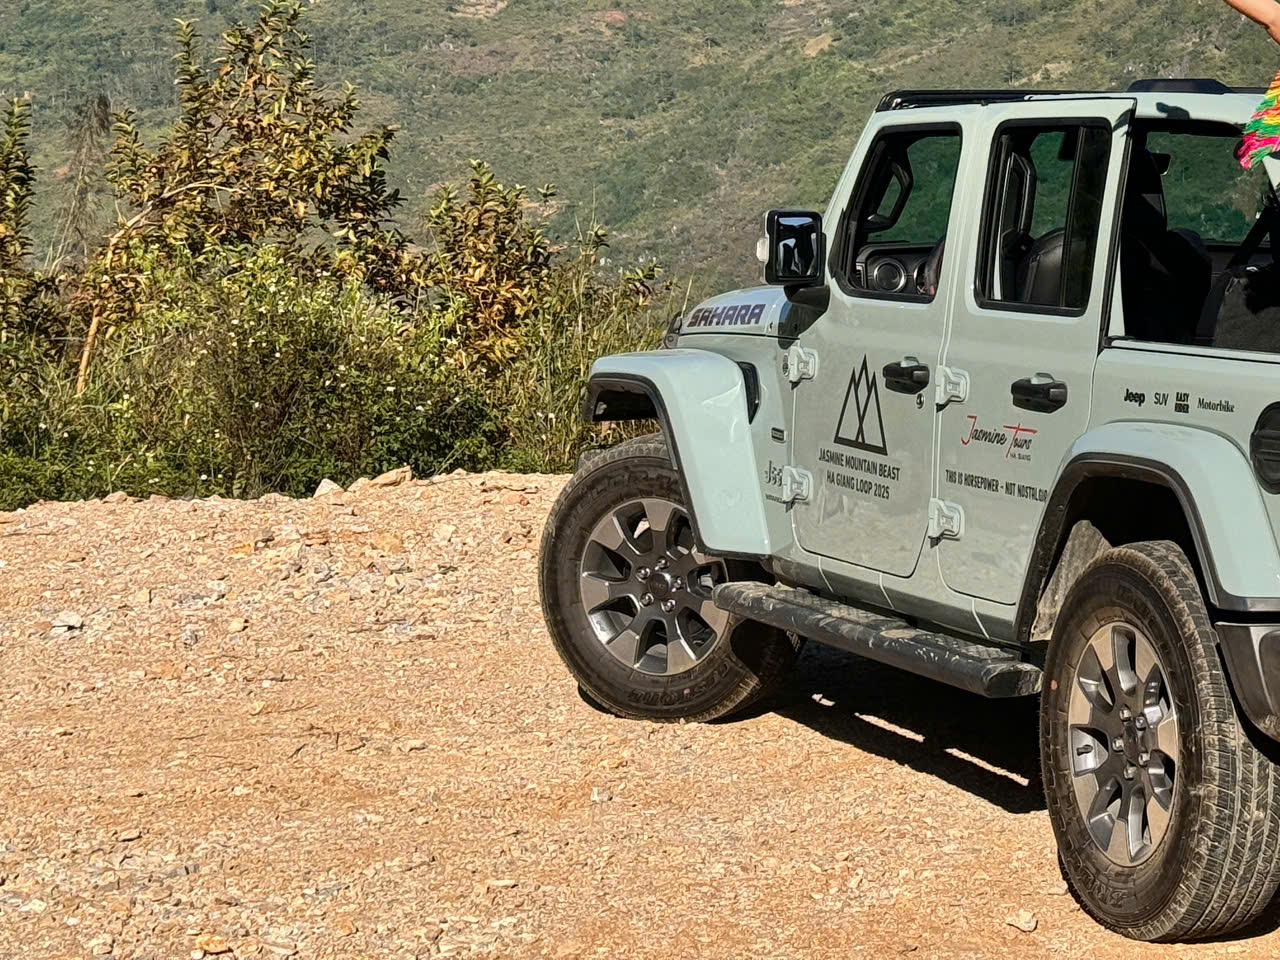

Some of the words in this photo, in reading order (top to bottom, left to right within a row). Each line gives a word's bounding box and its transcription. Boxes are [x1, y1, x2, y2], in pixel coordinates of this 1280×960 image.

[687, 304, 766, 327] SAHARA
[1124, 388, 1146, 407] Jeep
[1154, 392, 1169, 406] SUV
[1197, 398, 1236, 413] Motorbike
[961, 415, 1007, 446] Jasmine
[1003, 422, 1038, 458] Tours
[766, 460, 783, 488] Jee
[819, 448, 845, 467] JASMINE
[845, 455, 878, 478] MOUNTAIN
[878, 463, 901, 482] BEAST
[827, 470, 836, 485] HA
[836, 474, 855, 491] GIANG
[856, 479, 873, 495] LOOP
[874, 483, 890, 500] 2025
[946, 469, 957, 484] THIS
[958, 472, 963, 485] IS
[964, 473, 999, 493] HORSEPOWER
[1005, 481, 1016, 496] NOT
